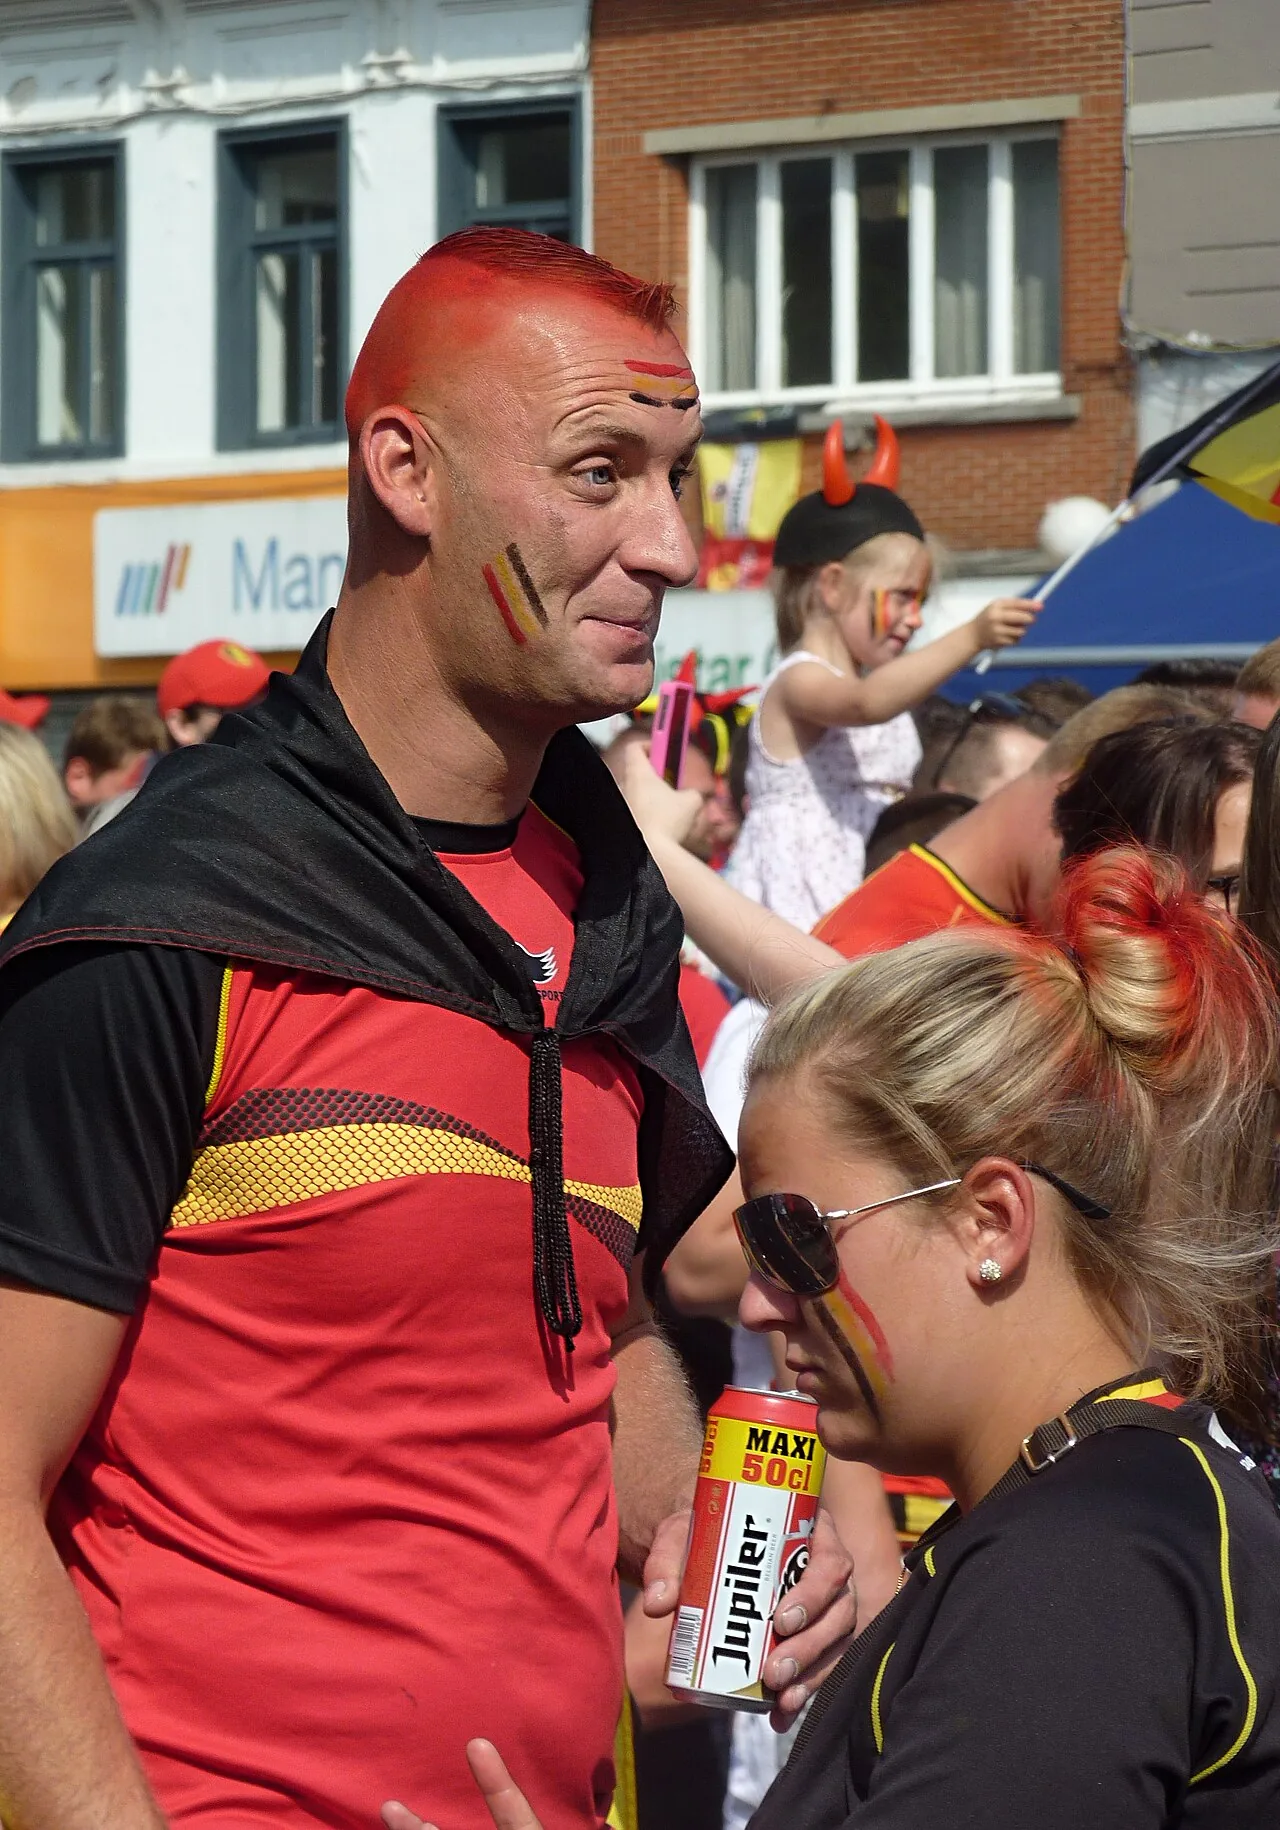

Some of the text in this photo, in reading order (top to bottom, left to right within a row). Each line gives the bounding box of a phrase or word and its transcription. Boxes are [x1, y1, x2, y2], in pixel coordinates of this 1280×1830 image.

[746, 1427, 816, 1461] MAXI
[741, 1453, 812, 1491] 50cl
[763, 1533, 778, 1582] BELGIAN BEER
[712, 1514, 769, 1678] Jupiler
